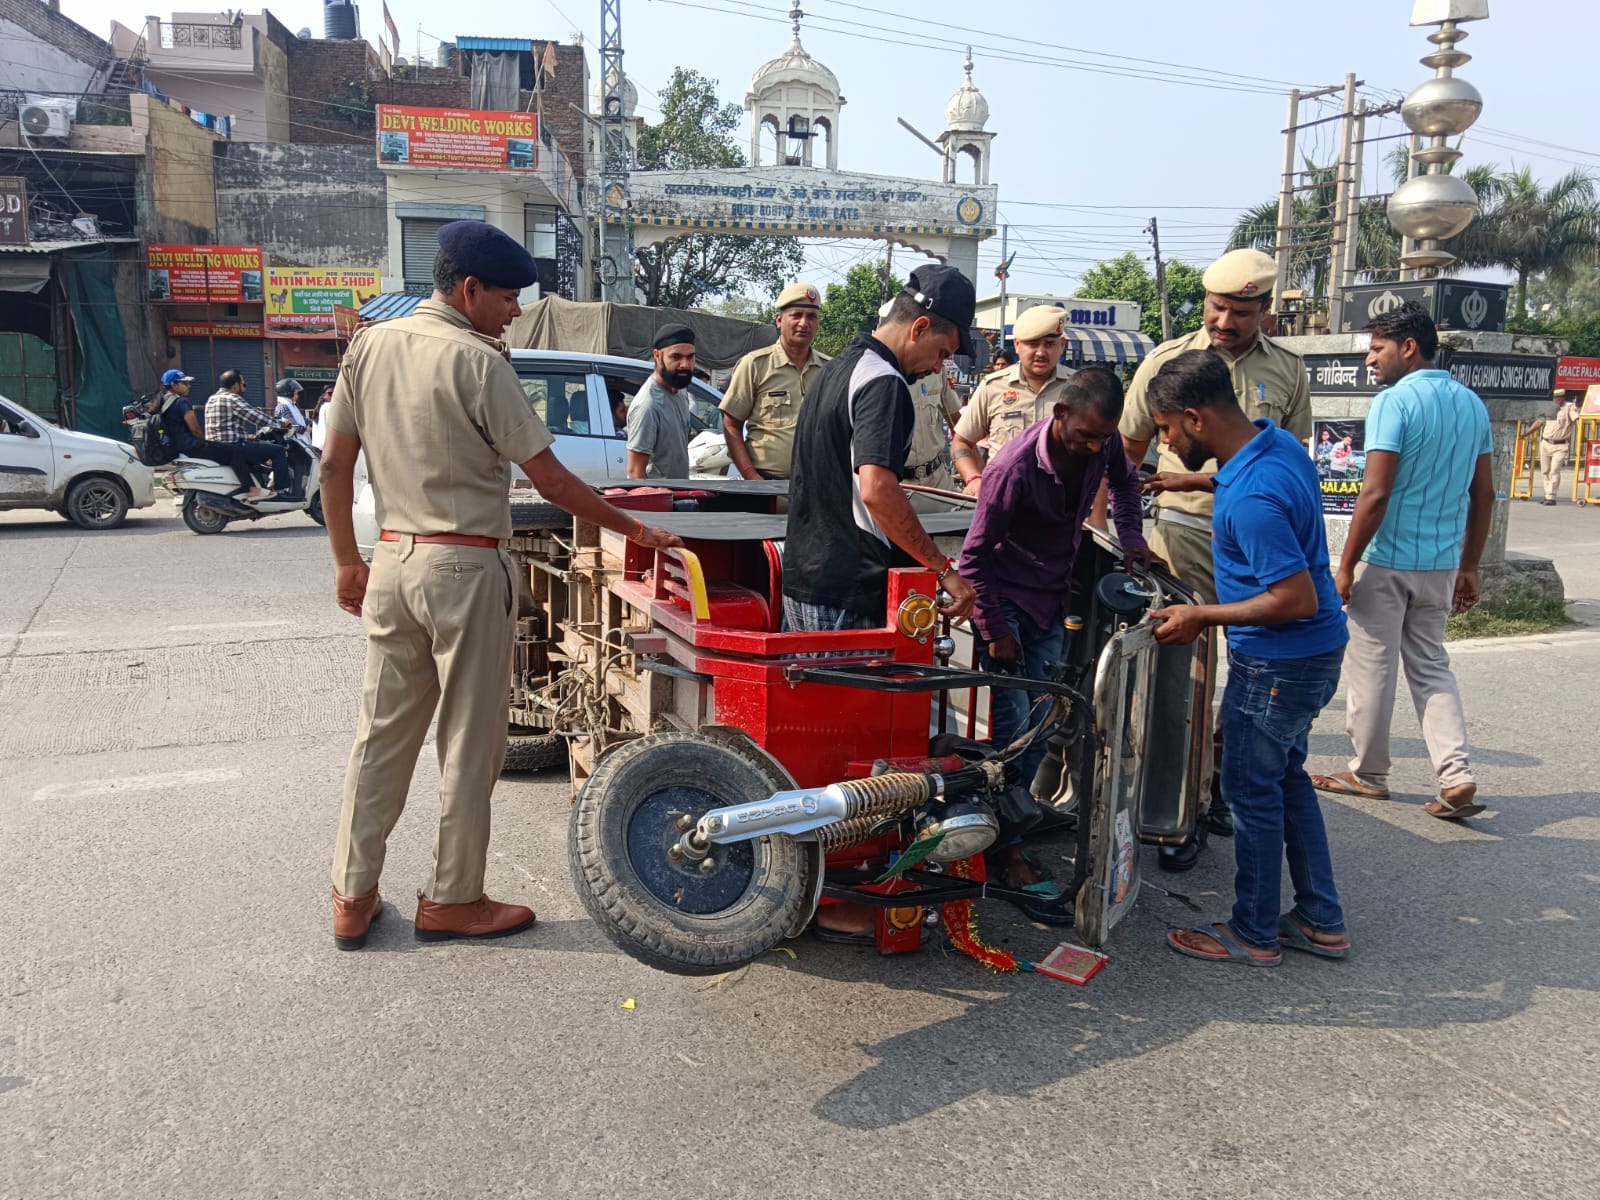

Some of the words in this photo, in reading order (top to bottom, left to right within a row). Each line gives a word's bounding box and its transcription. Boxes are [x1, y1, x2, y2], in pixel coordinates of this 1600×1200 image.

[383, 114, 416, 130] DEVI
[418, 116, 481, 134] WELDING
[484, 120, 533, 137] WORKS
[148, 253, 173, 267] DEVI
[175, 253, 221, 268] WELDNG
[223, 254, 259, 269] WORKS
[270, 276, 303, 286] NITIN
[306, 276, 337, 286] MEAT
[341, 277, 375, 287] SHOP
[1054, 302, 1116, 326] mul
[173, 326, 193, 335] DEVI
[232, 327, 260, 335] WORKS
[1316, 358, 1359, 388] गोबिन्द
[1450, 364, 1471, 387] GURU
[1471, 364, 1500, 388] GOBIND
[1500, 365, 1523, 389] SINGH
[1524, 367, 1551, 390] CHOWK
[1558, 365, 1580, 377] GRACE
